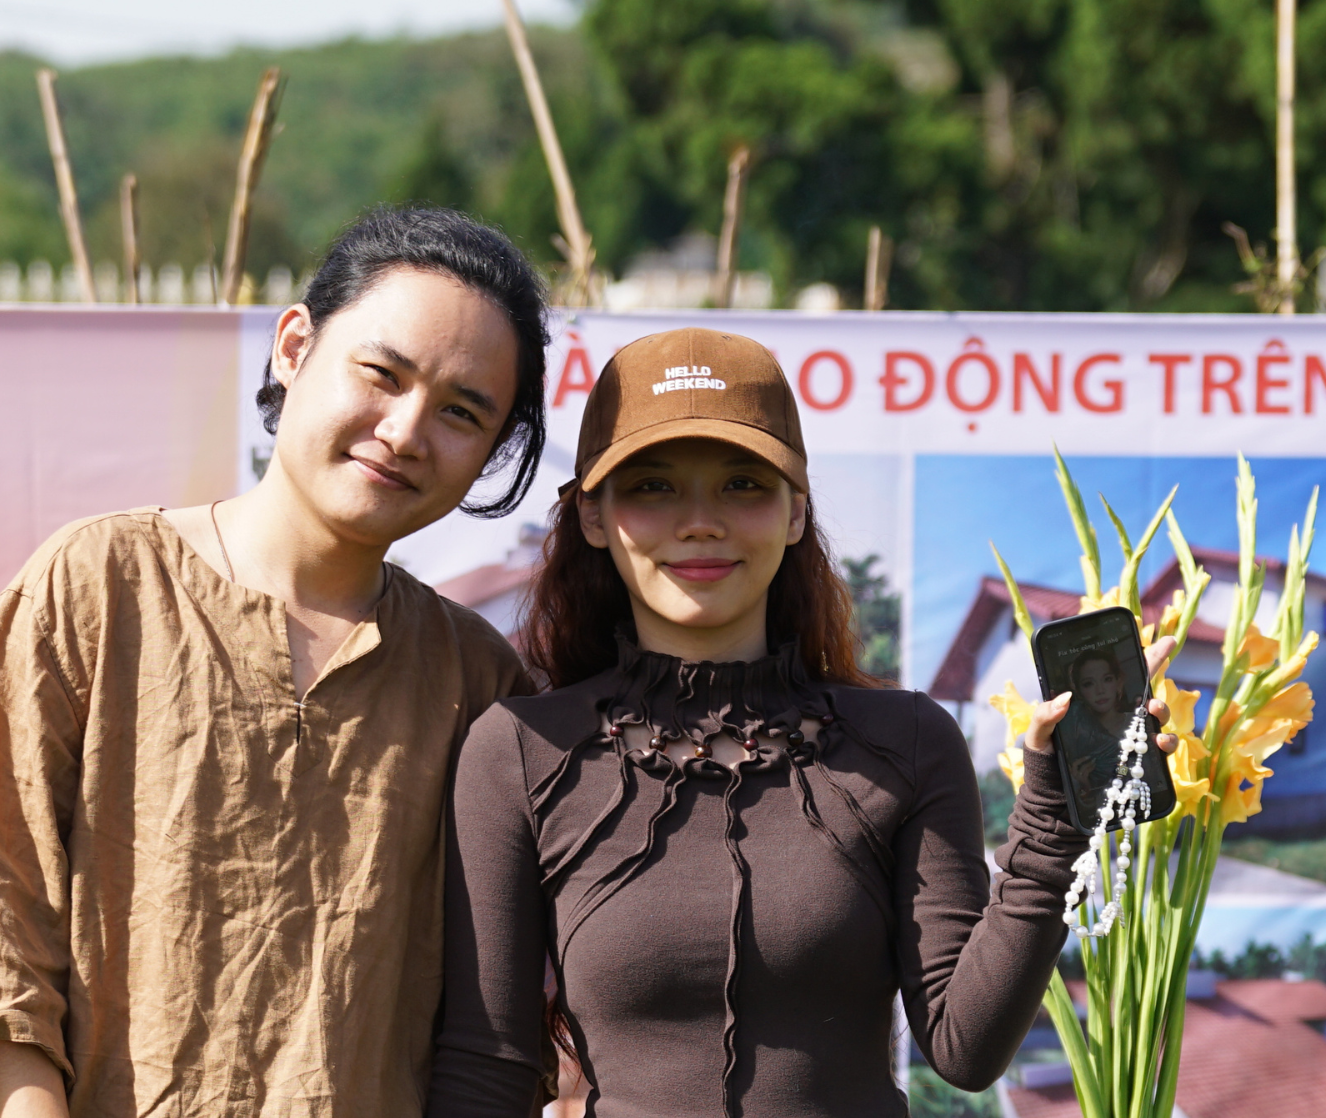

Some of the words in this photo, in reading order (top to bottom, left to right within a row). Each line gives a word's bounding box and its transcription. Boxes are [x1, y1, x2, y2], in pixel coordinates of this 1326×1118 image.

[665, 365, 712, 380] HELLO
[652, 377, 727, 396] WEEKEND
[878, 336, 1125, 432] ĐỘNG
